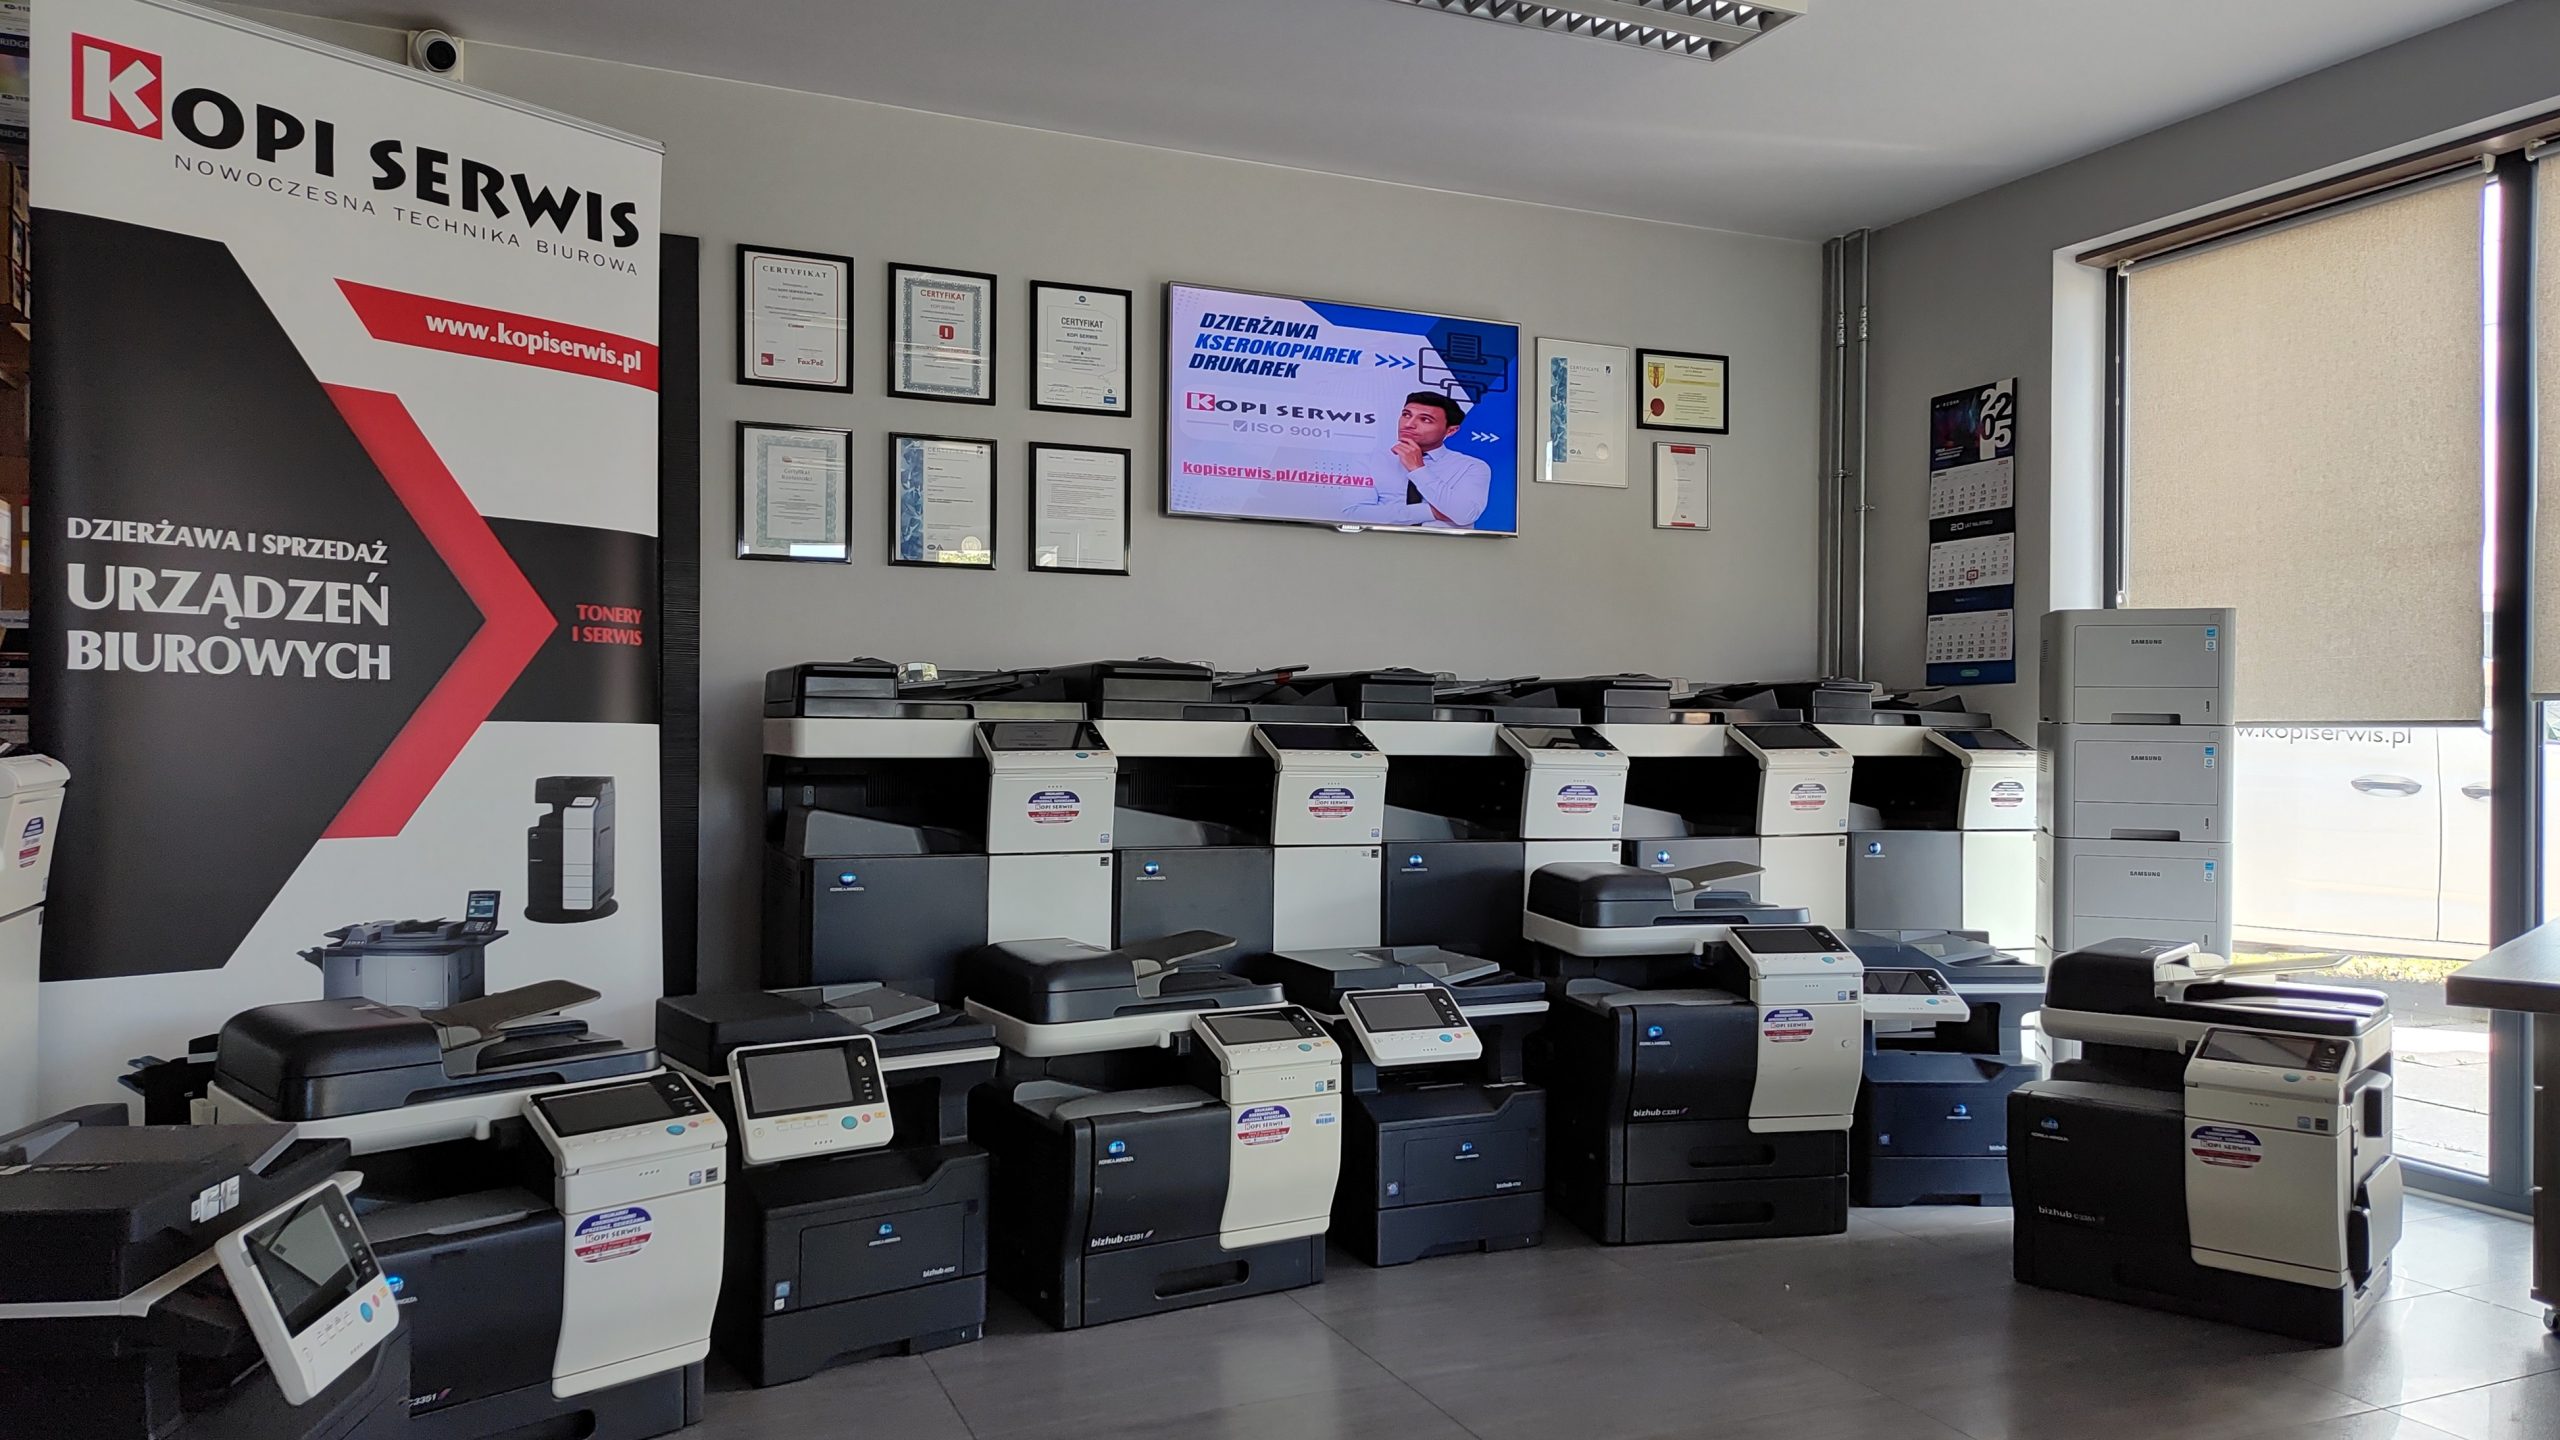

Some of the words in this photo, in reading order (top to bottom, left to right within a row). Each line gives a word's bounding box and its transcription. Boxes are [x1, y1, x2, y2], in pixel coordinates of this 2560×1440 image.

[73, 34, 334, 178] KOPI
[370, 139, 639, 248] SERWIS
[174, 155, 376, 214] NOWOCZESNA
[394, 207, 520, 248] TECHNIKA
[536, 239, 638, 275] BIUROWA
[762, 265, 828, 279] CERTYFIKAT
[920, 289, 966, 301] CERTYFIKAT
[1061, 317, 1104, 329] CERTYFIKAT
[1199, 312, 1319, 340] DZIERŻAWA
[425, 314, 641, 371] www.kopiserwis.pl
[1193, 333, 1363, 366] KSEROKOPIAREK
[1188, 353, 1301, 379] DRUKAREK
[1186, 392, 1267, 416] KOPI
[1277, 404, 1377, 425] SERWIS
[1251, 422, 1284, 435] ISO
[1290, 425, 1332, 439] 9001
[67, 516, 241, 552] DZIERŻAWA
[248, 534, 256, 553] I
[262, 534, 388, 565] SPRZEDAŻ
[67, 563, 389, 629] URZĄDZEŃ
[576, 604, 642, 626] TONERY
[572, 626, 579, 642] I
[582, 626, 642, 646] SERWIS
[66, 629, 391, 681] BIUROWYCH
[1633, 1108, 1661, 1117] bizhub
[2038, 1204, 2073, 1219] bizhub
[611, 1226, 642, 1238] SERWIS
[1091, 1234, 1123, 1248] bizhub
